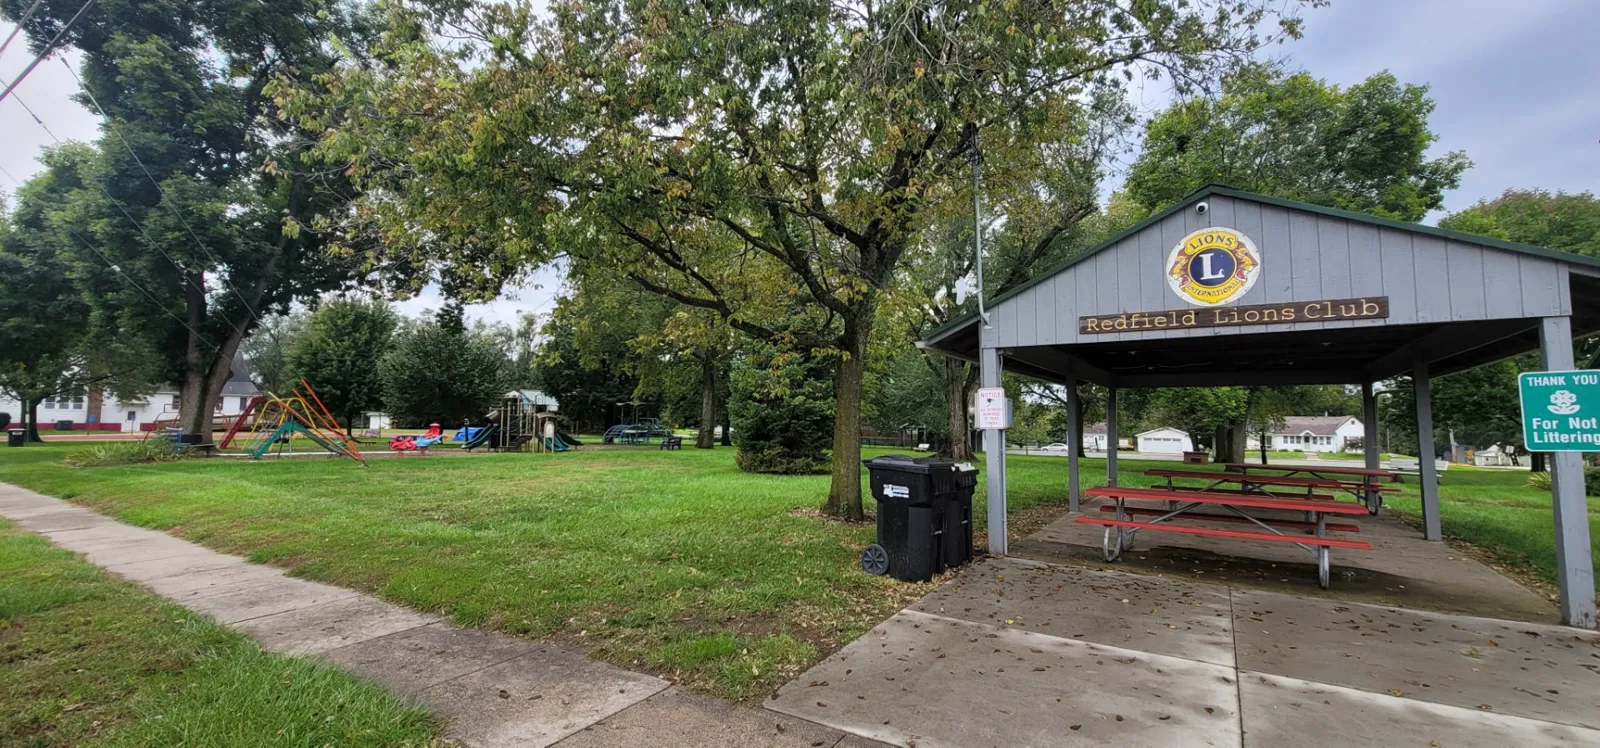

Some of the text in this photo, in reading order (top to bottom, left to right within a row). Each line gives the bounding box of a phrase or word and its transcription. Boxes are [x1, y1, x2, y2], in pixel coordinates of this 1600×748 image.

[1189, 234, 1233, 250] LIONS
[1199, 252, 1225, 280] L
[1187, 280, 1240, 297] INTERNATIONAL
[1086, 299, 1380, 332] Redfield Lions Club
[1527, 374, 1598, 387] THANK YOU
[1532, 417, 1598, 429] For Not
[1533, 431, 1600, 445] Littering
